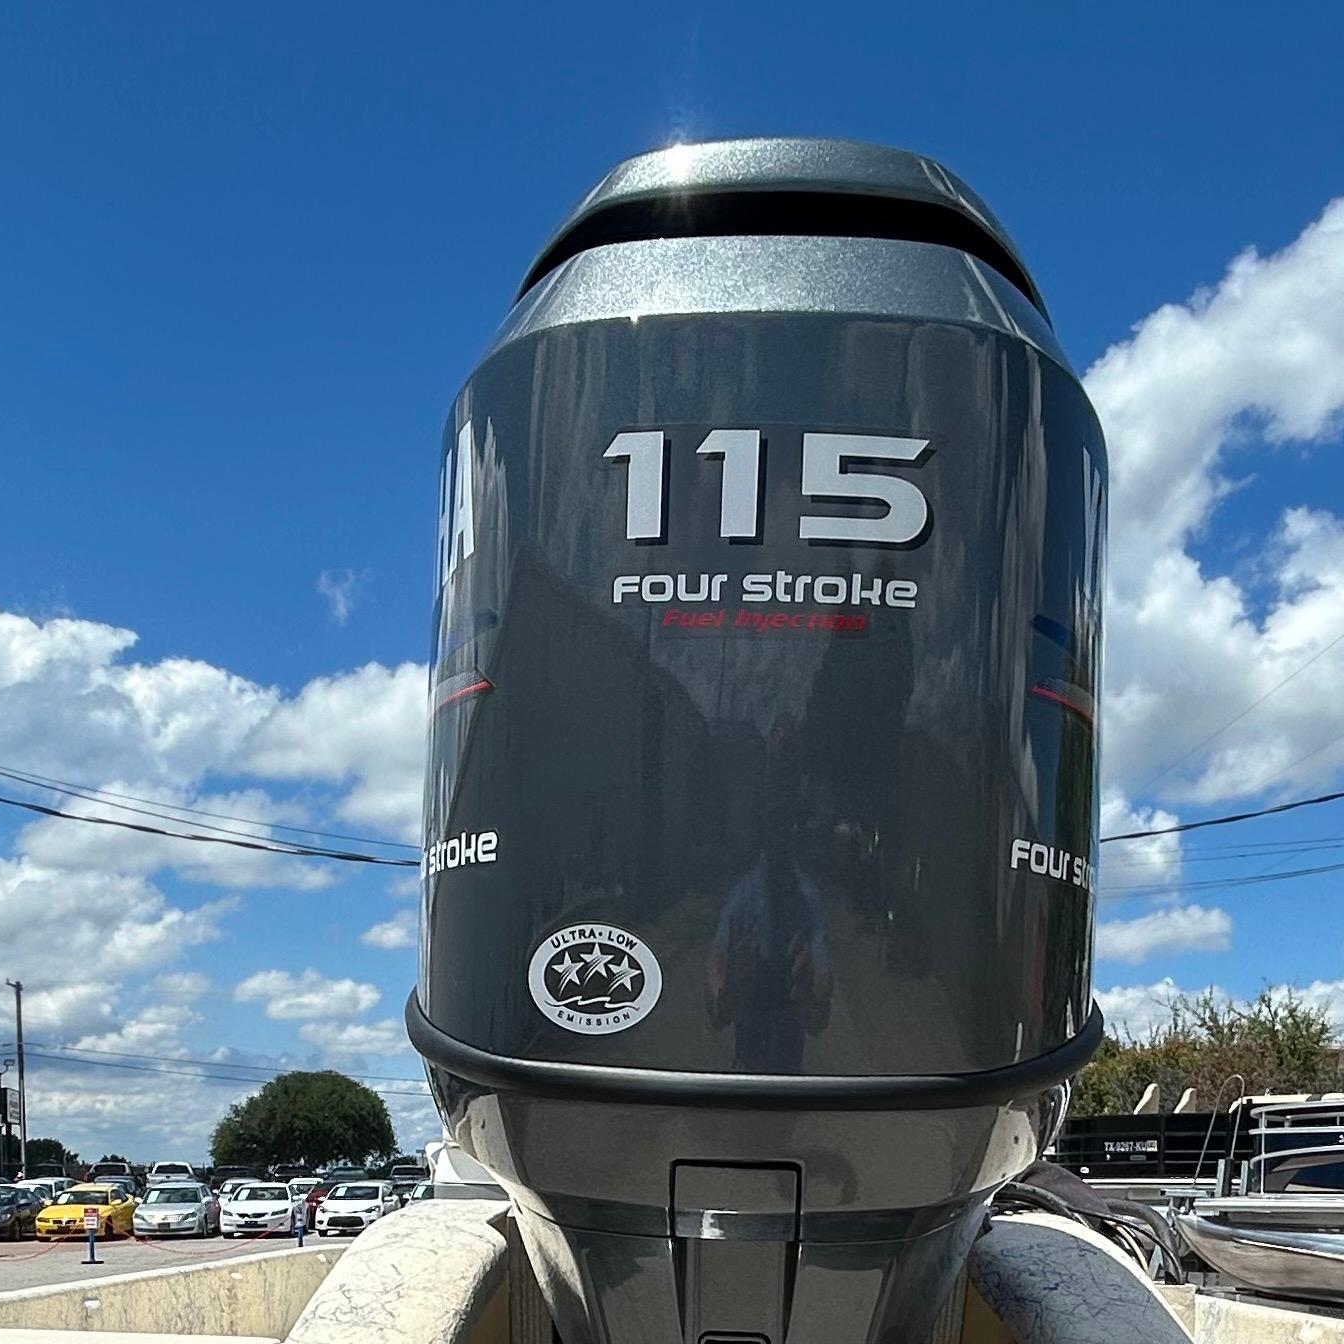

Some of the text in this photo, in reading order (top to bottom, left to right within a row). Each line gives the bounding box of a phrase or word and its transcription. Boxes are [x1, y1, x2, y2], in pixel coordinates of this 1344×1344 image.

[603, 429, 930, 543] 115
[550, 928, 638, 951] ULTRA LOW
[556, 1010, 631, 1026] EMISSION
